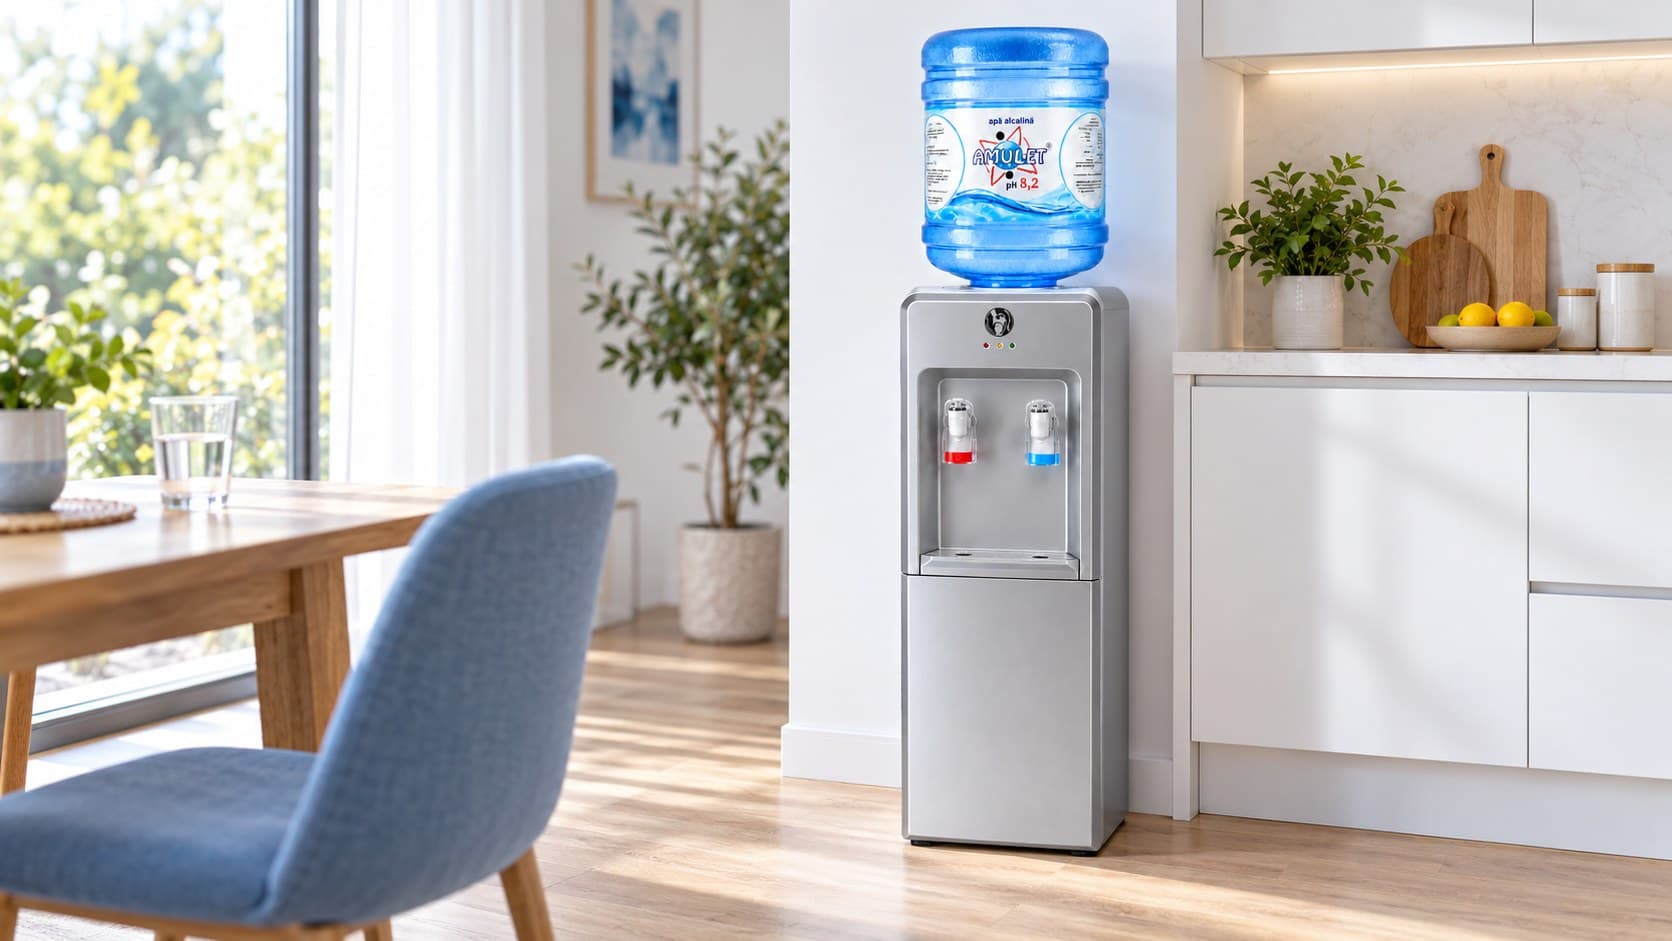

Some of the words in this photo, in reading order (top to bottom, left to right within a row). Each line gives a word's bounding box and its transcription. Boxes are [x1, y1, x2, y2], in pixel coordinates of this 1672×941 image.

[1004, 117, 1034, 125] alcalină
[972, 147, 1048, 166] AMULET
[1006, 181, 1018, 191] pH
[1020, 177, 1039, 191] 8,2
